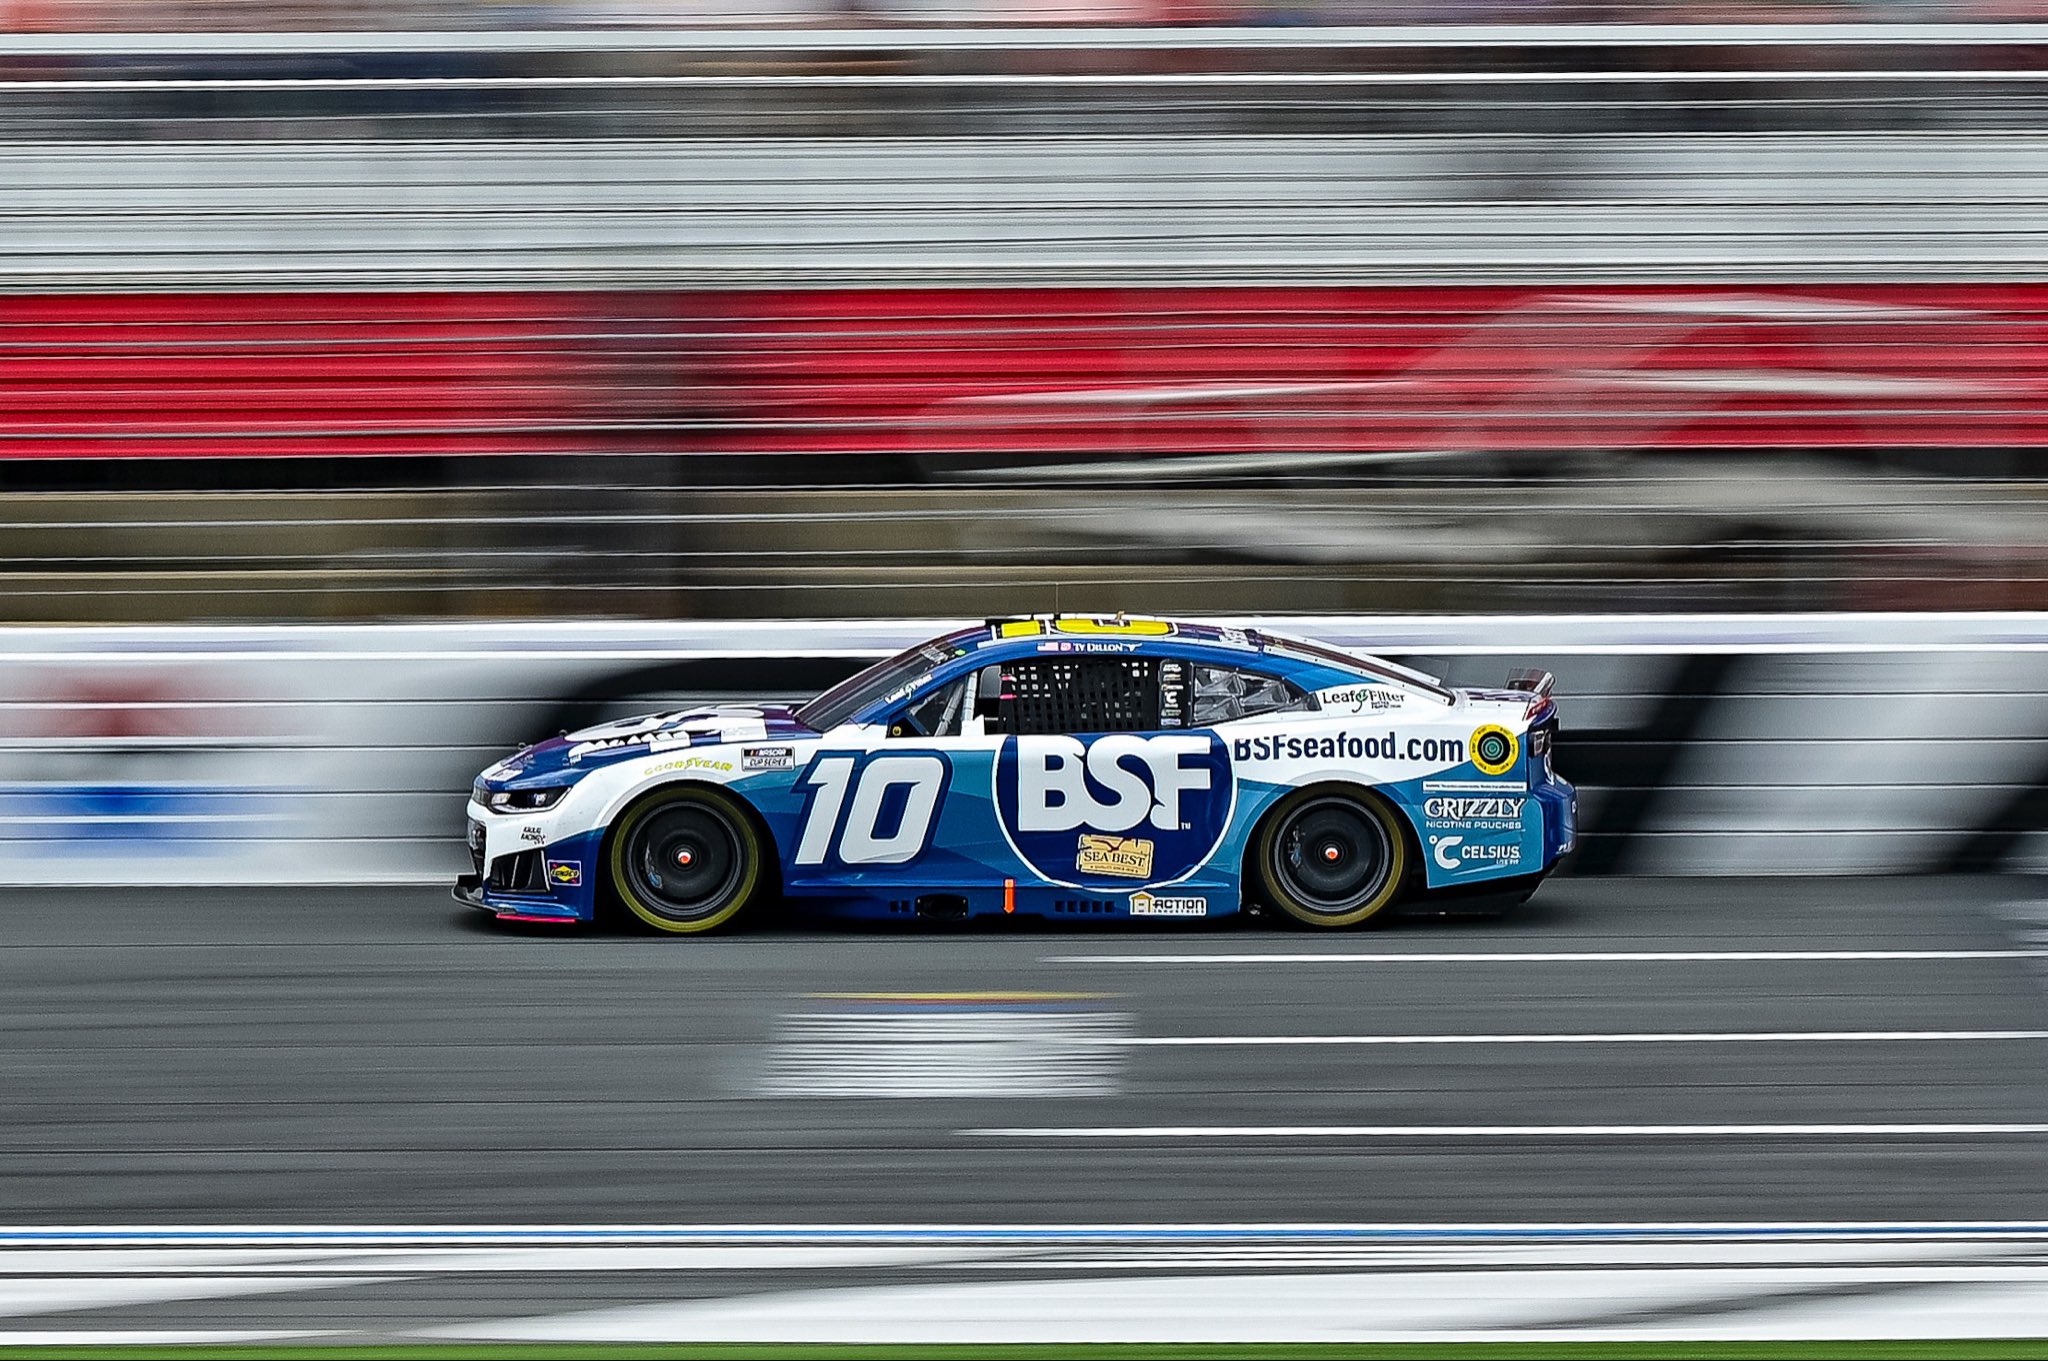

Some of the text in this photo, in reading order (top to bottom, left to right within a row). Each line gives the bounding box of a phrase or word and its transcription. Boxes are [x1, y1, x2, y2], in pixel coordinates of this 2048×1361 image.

[1072, 643, 1123, 652] TY DILLON
[1234, 731, 1464, 762] BSFseafood.com
[643, 757, 734, 776] GOODYEAR
[1017, 735, 1211, 832] BSF
[794, 757, 945, 865] 10
[1424, 797, 1526, 820] GRIZZLY
[1425, 821, 1522, 829] NICOTINE POUCHES
[1083, 851, 1145, 867] SEA BEST
[1461, 845, 1521, 859] CELSIUS
[1153, 899, 1205, 910] ACTION
